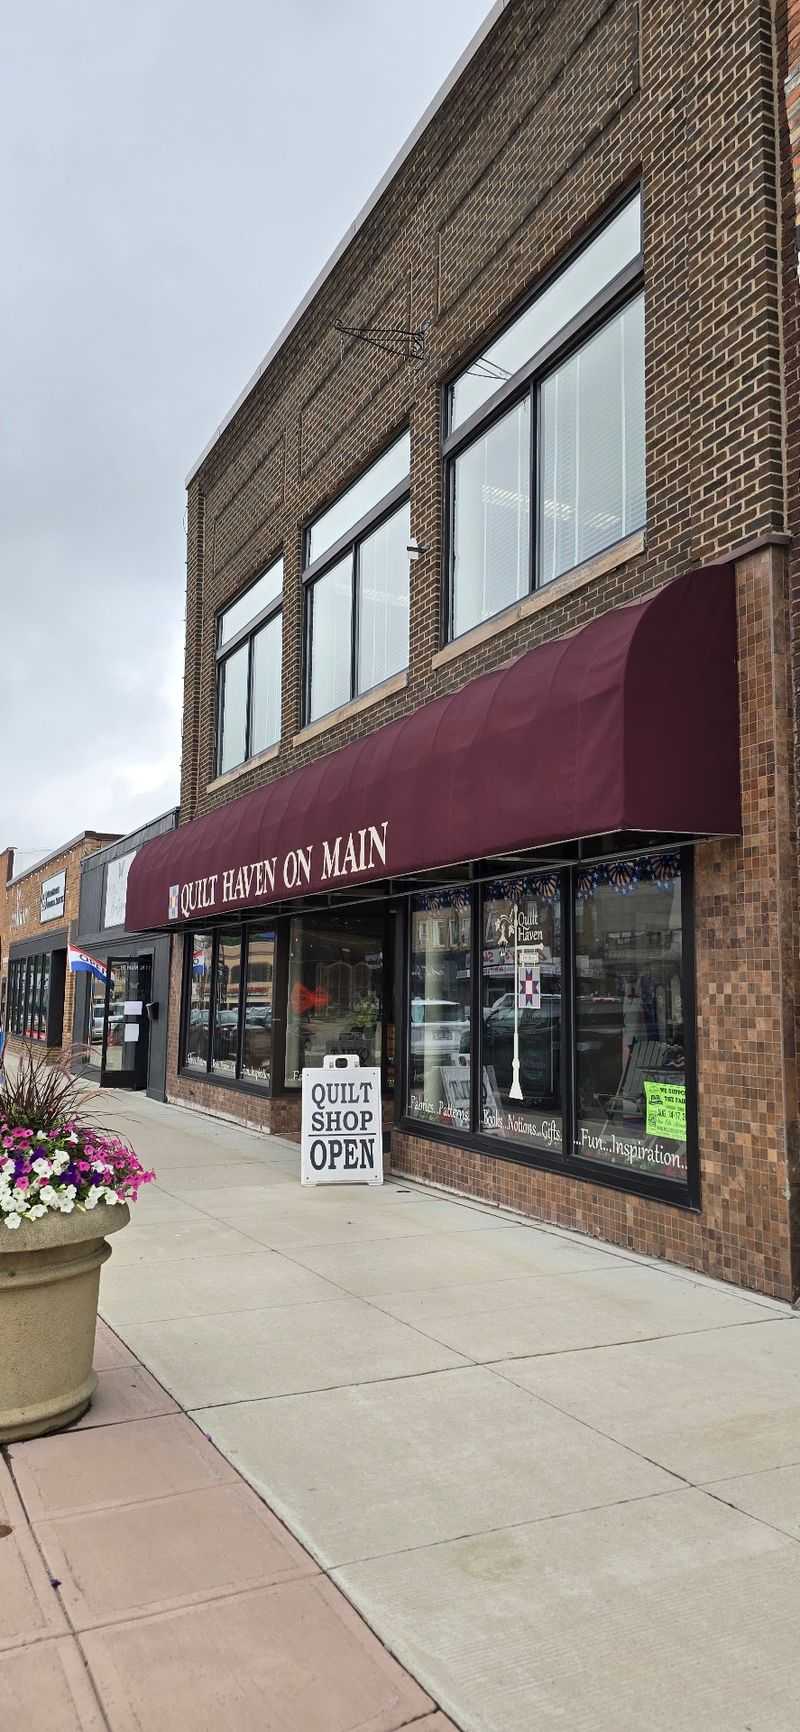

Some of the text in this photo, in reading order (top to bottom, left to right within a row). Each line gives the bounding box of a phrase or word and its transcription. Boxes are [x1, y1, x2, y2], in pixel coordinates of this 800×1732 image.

[181, 821, 389, 917] QUILT HAVEN ON MAIN
[518, 909, 538, 930] Quilt
[518, 927, 543, 941] Haven
[311, 1082, 373, 1110] QUILT
[311, 1110, 374, 1132] SHOP
[309, 1138, 375, 1171] OPEN
